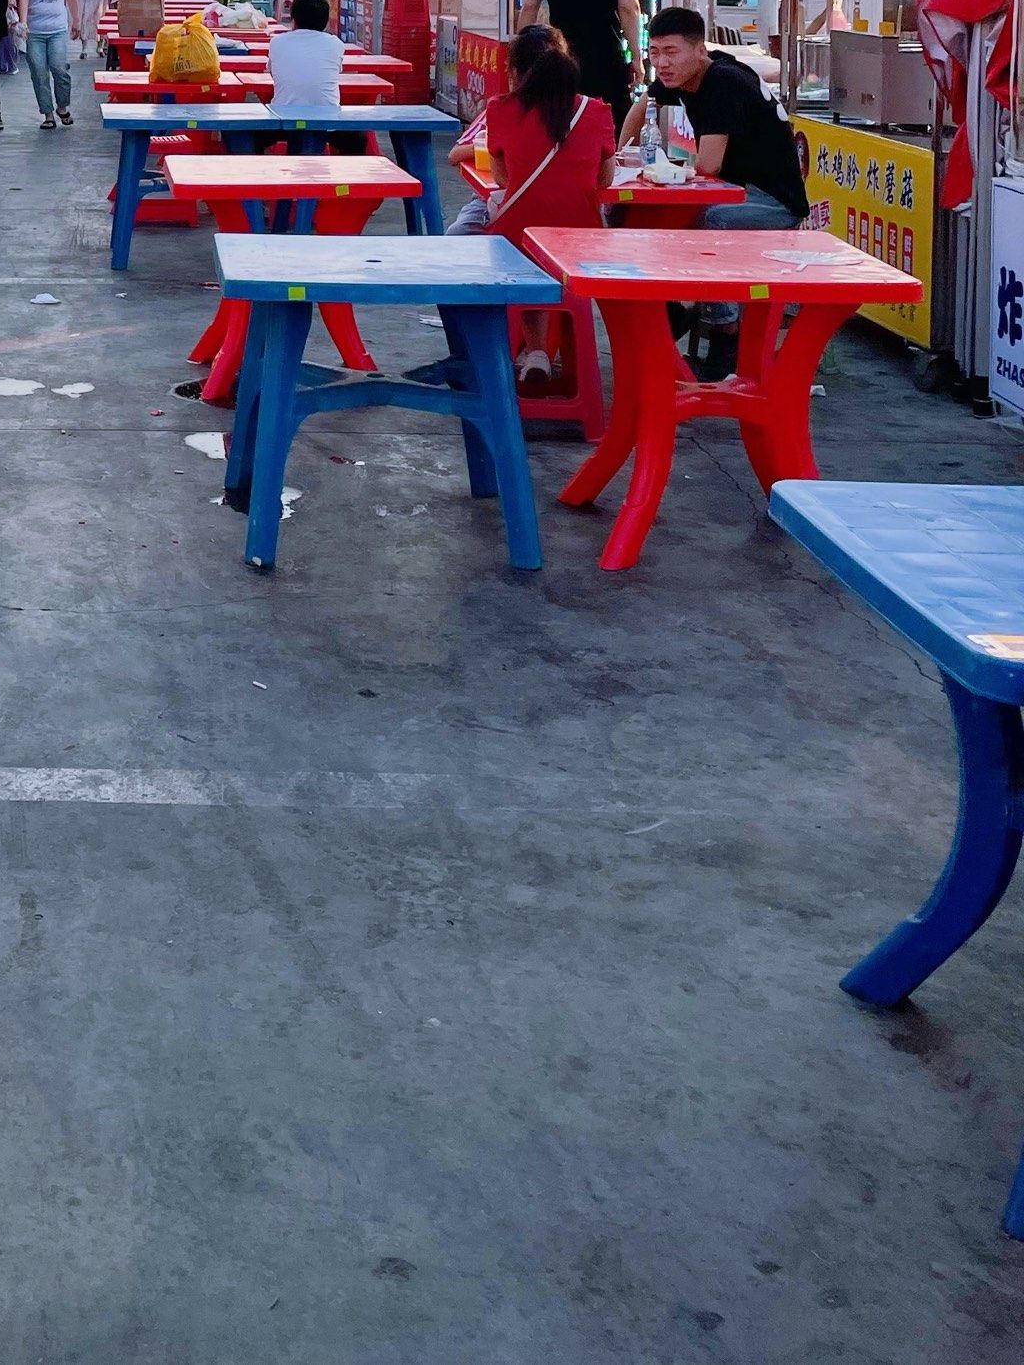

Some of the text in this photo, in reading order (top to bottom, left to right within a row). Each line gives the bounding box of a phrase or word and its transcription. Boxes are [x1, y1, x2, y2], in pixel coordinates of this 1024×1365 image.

[866, 159, 914, 211] 炸蘑菇
[998, 266, 1023, 347] 炸
